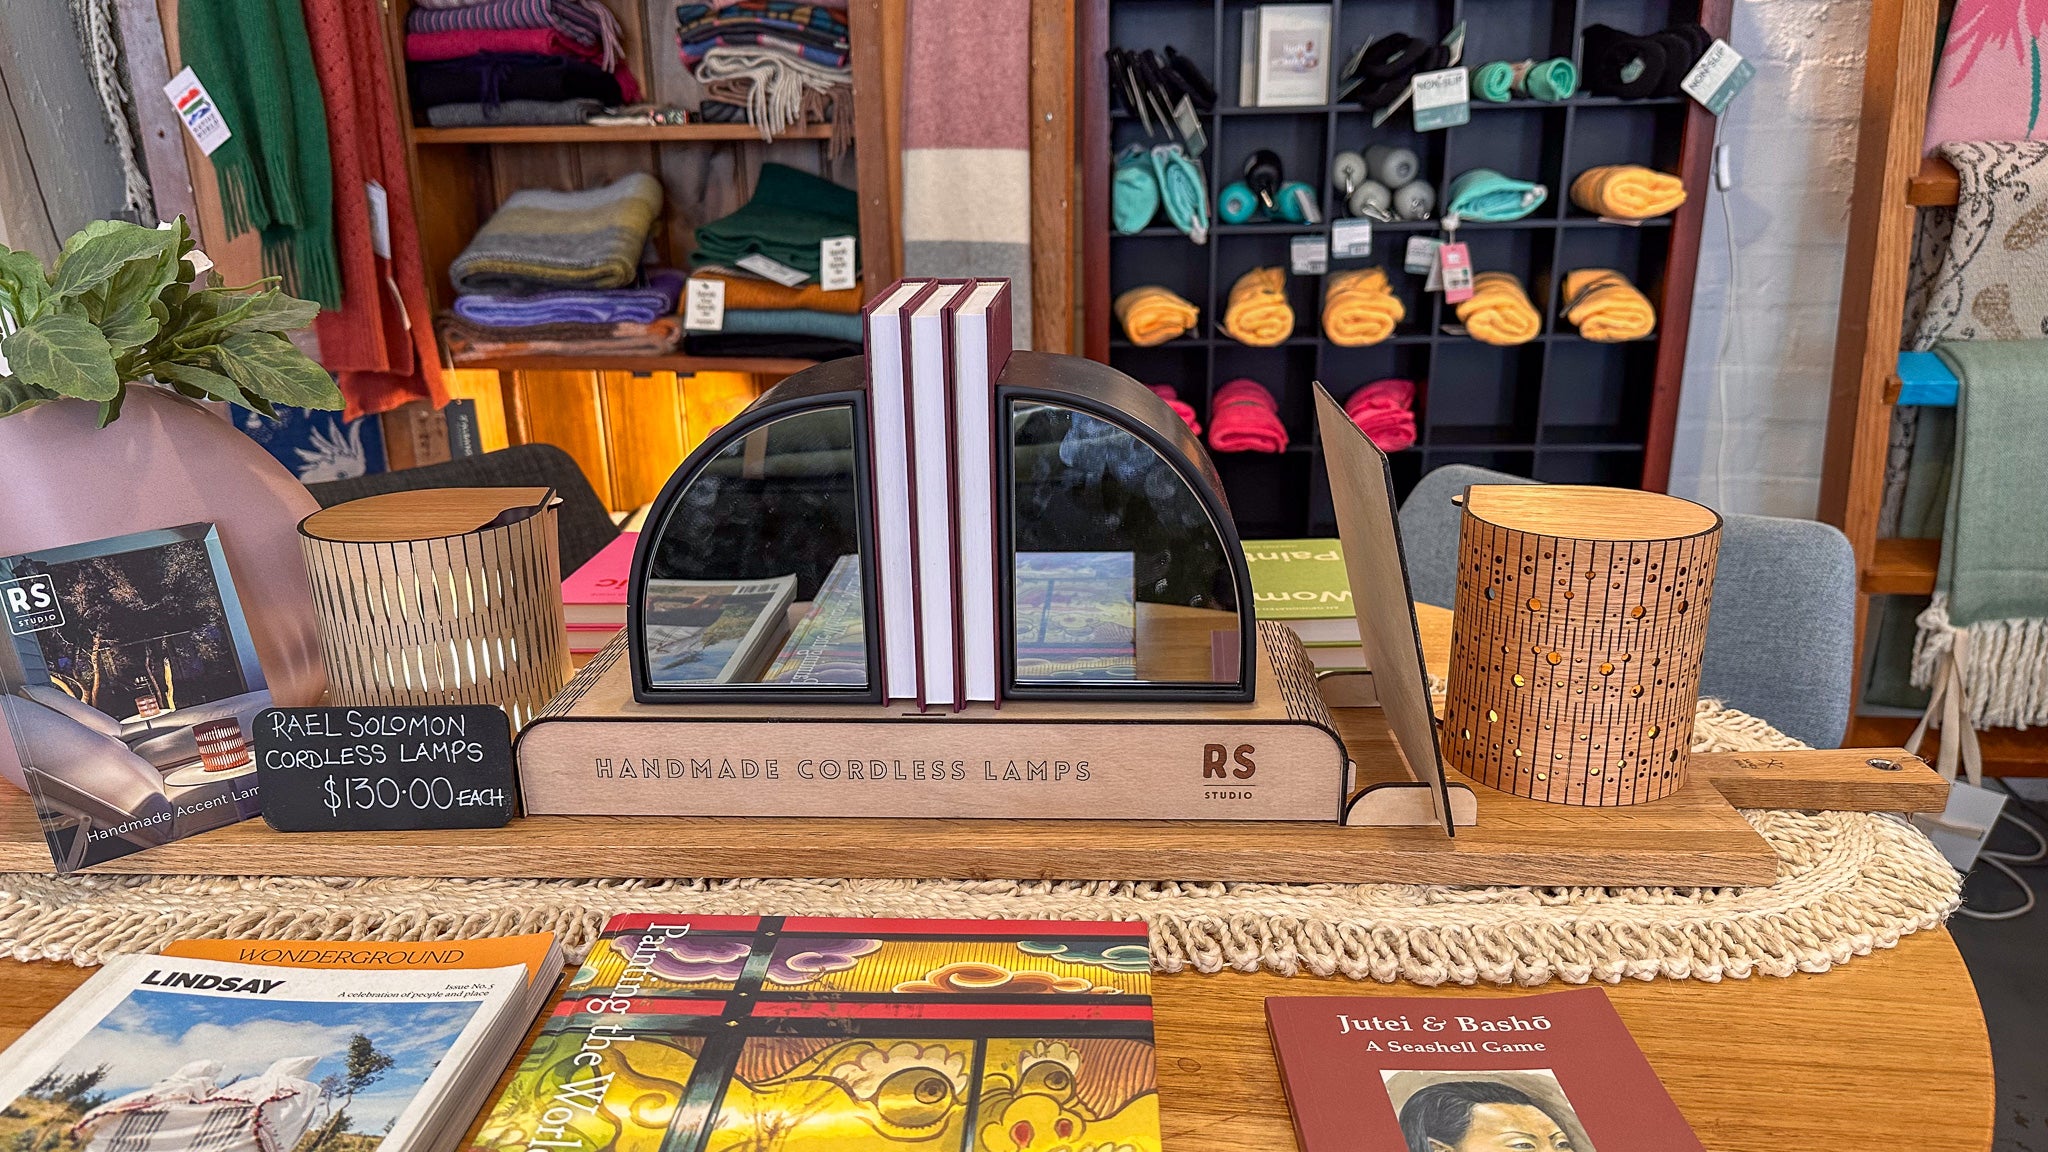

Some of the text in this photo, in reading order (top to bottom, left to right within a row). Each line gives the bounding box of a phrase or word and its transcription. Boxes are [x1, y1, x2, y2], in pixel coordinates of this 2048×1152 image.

[6, 583, 51, 613] RS
[18, 614, 56, 627] STUDIO
[267, 710, 465, 741] RAEL SOLOMON
[265, 740, 483, 769] CORDLESS LAMPS
[1203, 743, 1256, 779] RS
[595, 758, 1091, 781] HANDMADE CORDLESS LAMPS
[456, 788, 505, 807] EACH
[1204, 791, 1252, 800] STUDIO
[86, 811, 172, 843] Handmade
[176, 794, 229, 817] Accent
[238, 948, 465, 965] WONDERGROUND
[141, 969, 286, 995] LINDSAY
[347, 990, 400, 998] celebration
[411, 991, 443, 999] people
[464, 990, 490, 998] place
[1336, 1014, 1552, 1034] Jutei & Bashō
[526, 922, 690, 1152] Painting the Worl
[1366, 1040, 1547, 1053] A Seashell Game
